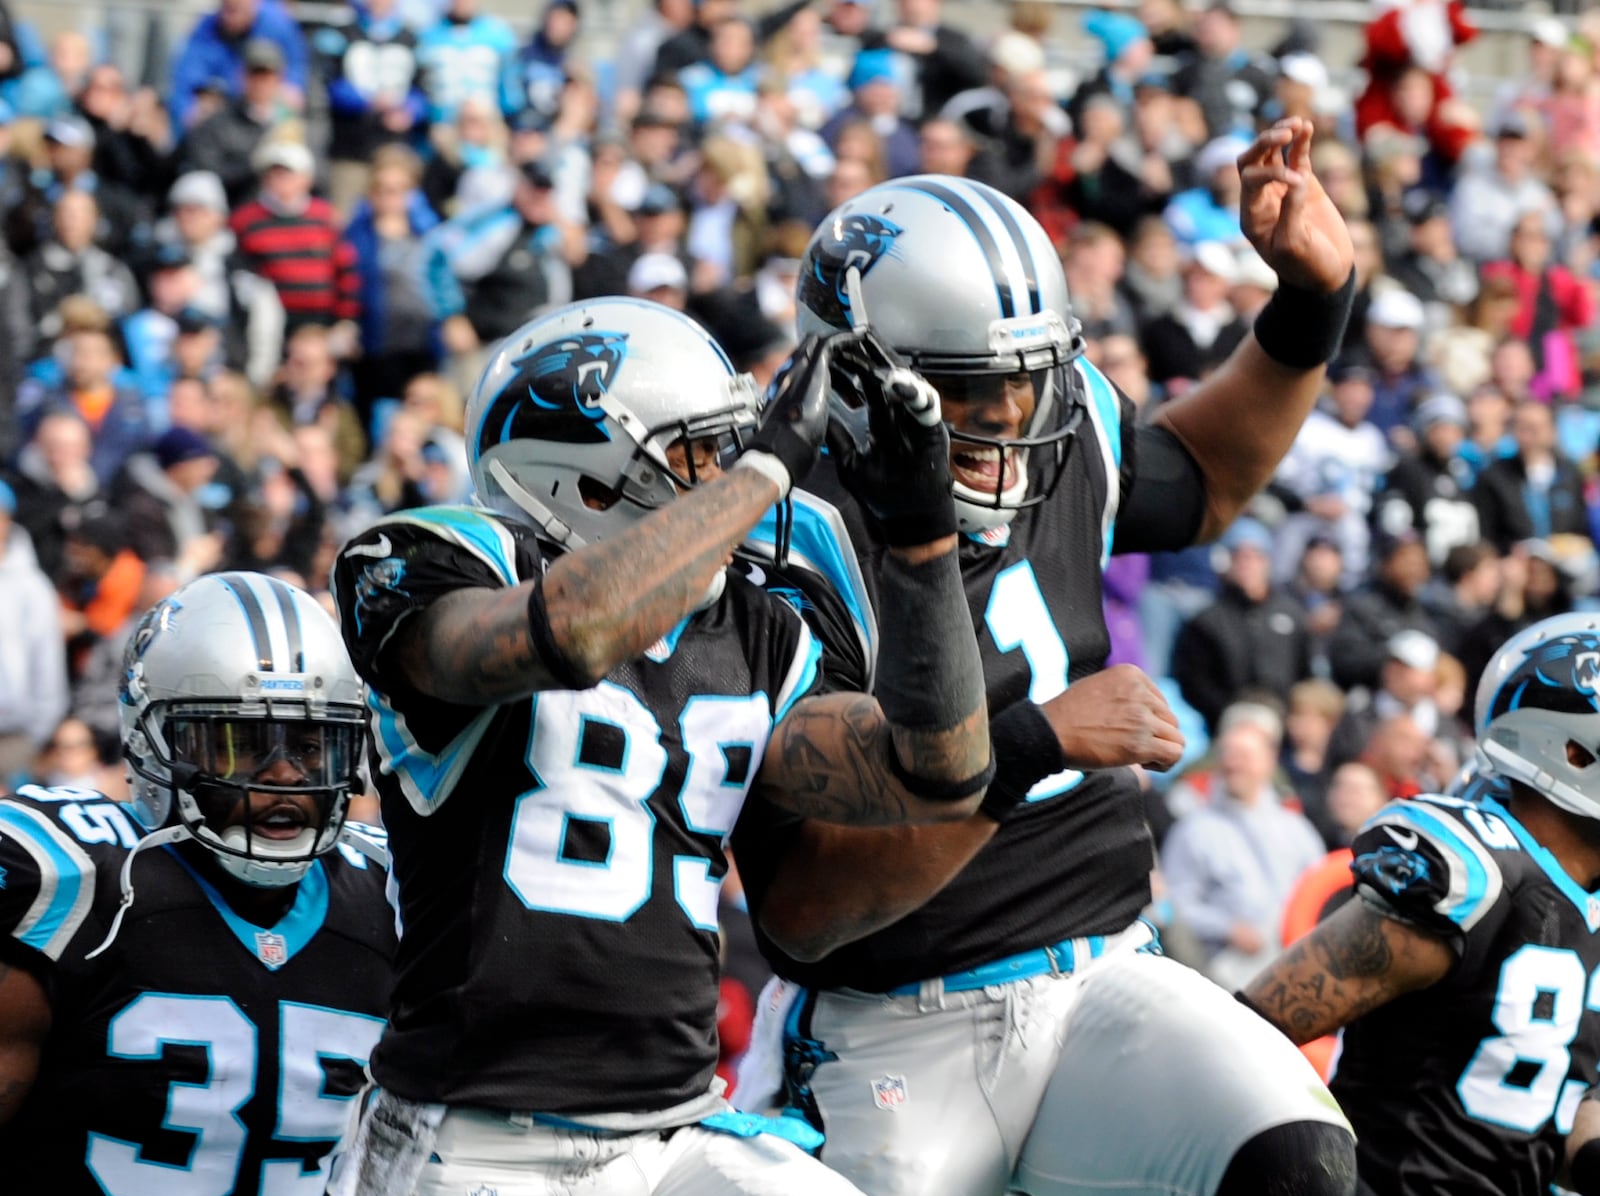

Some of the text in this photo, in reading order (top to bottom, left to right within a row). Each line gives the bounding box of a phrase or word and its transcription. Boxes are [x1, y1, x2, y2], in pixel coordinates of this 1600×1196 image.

[260, 679, 305, 691] PANTHERS
[984, 558, 1085, 803] 1
[503, 679, 773, 932] 89
[879, 1088, 905, 1106] NFL
